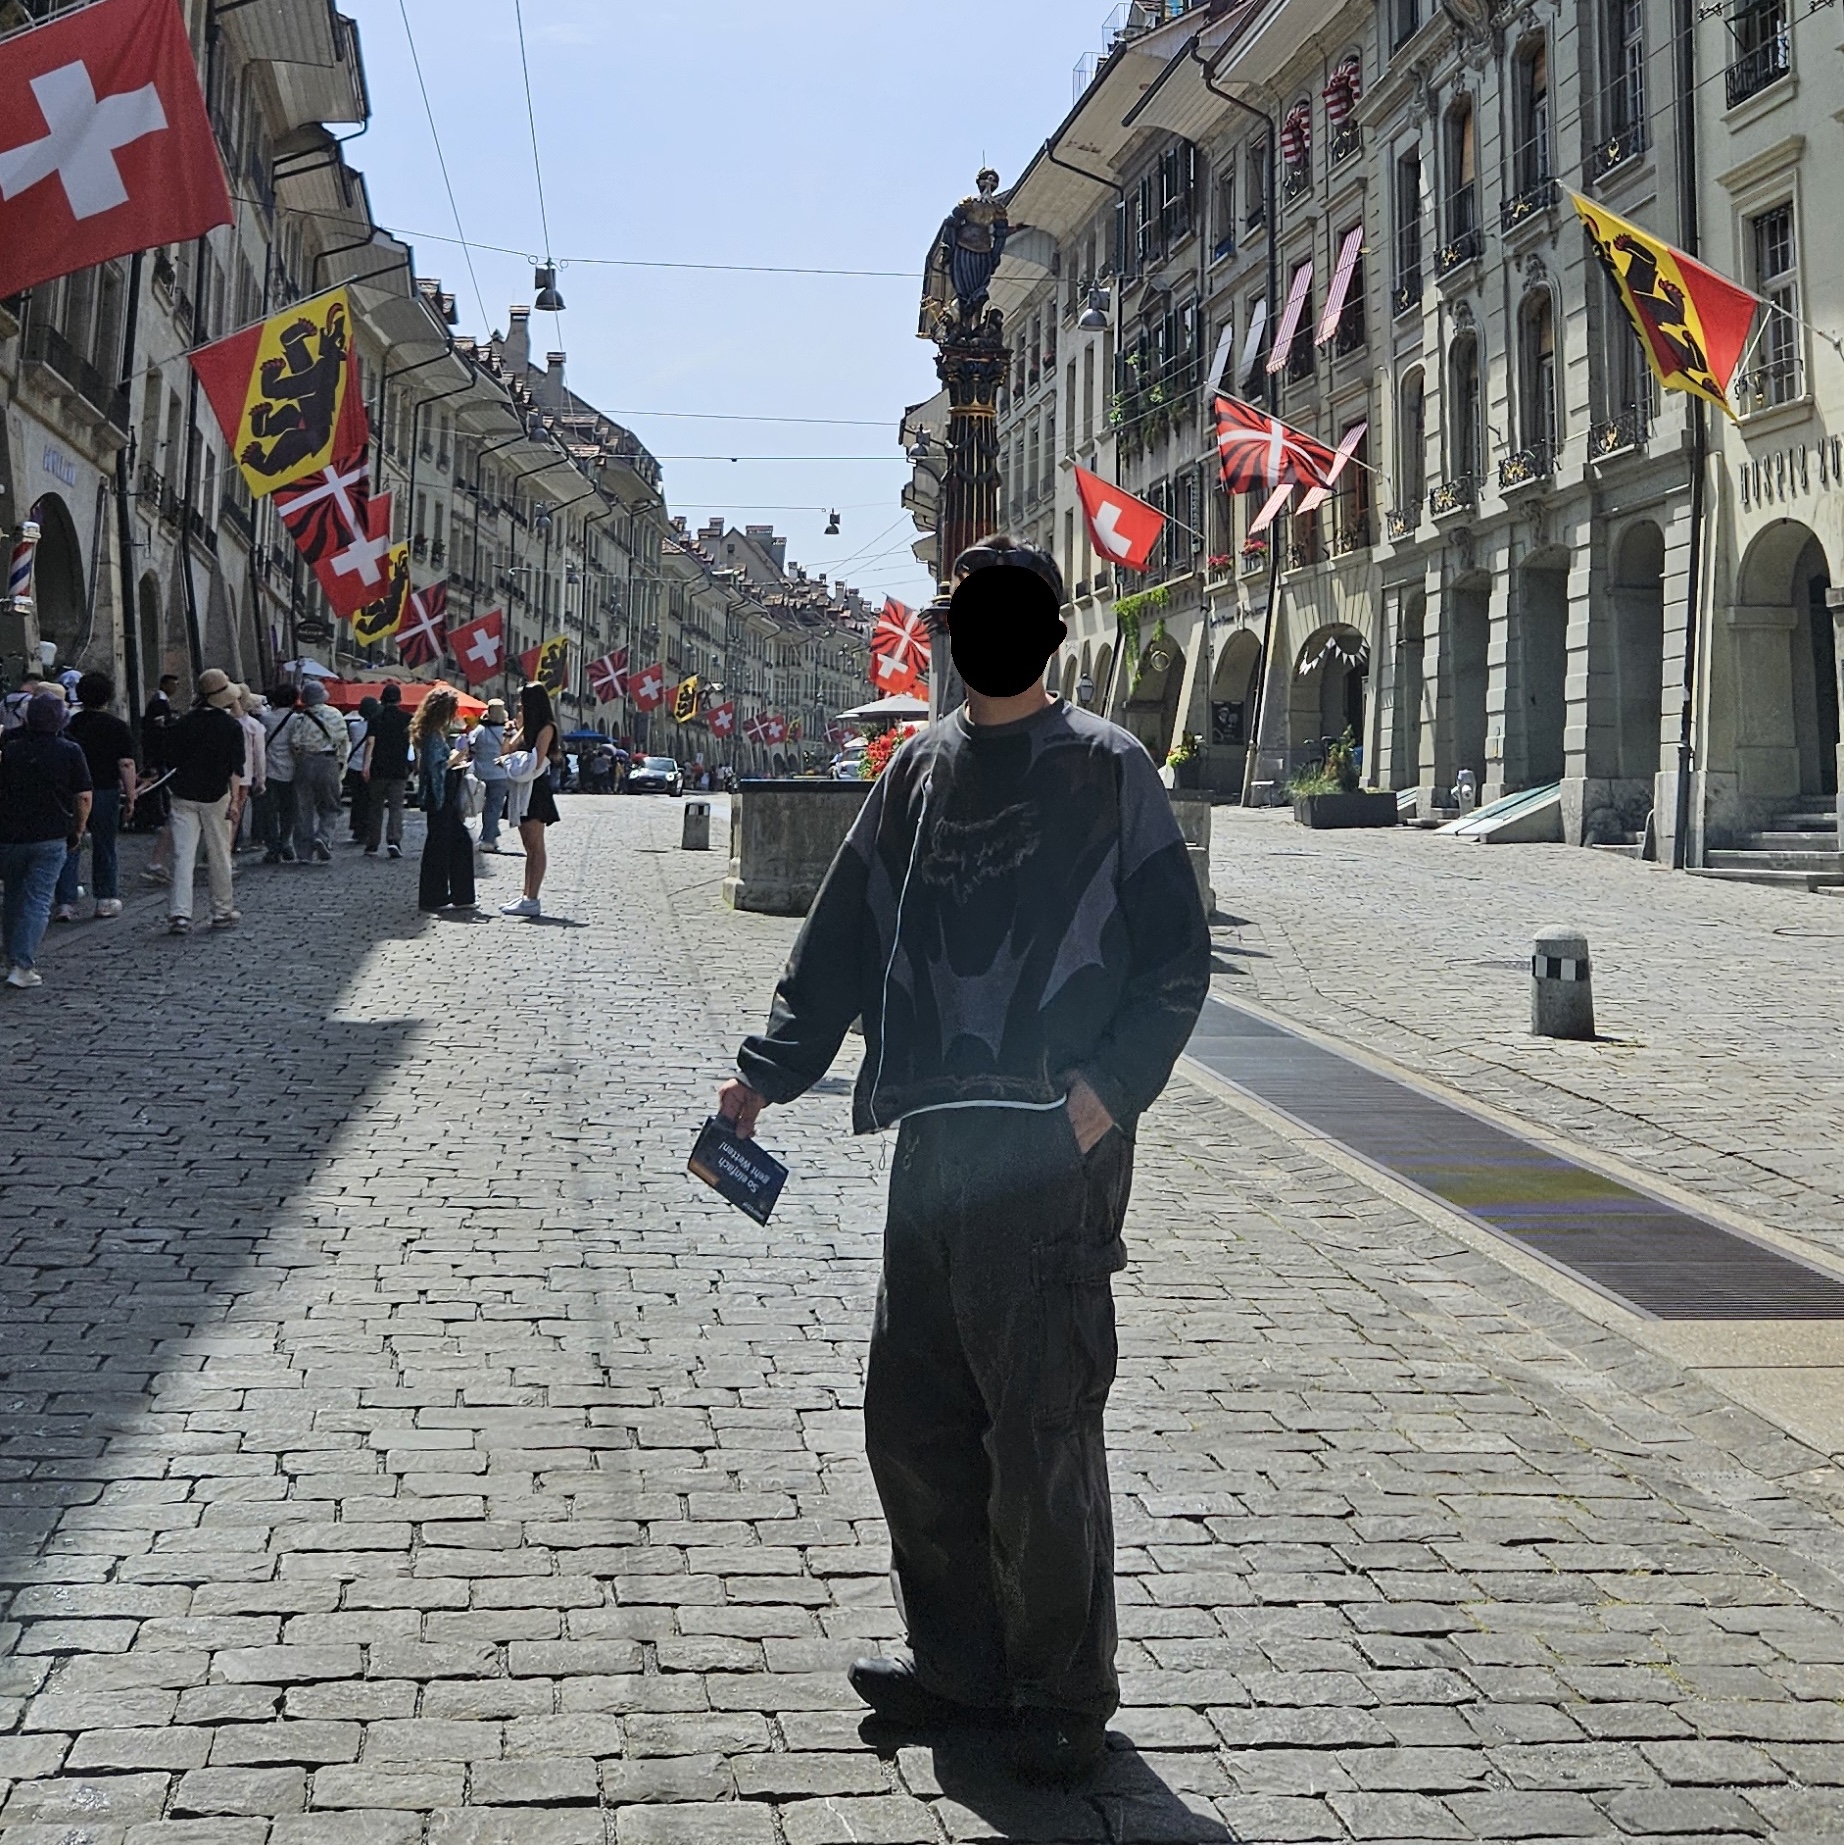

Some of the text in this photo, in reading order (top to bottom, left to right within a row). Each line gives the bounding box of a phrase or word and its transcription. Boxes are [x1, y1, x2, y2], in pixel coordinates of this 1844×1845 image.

[1738, 444, 1806, 503] HOSPIZ
[718, 1142, 751, 1172] Wetten!
[718, 1157, 759, 1193] So einfach
[750, 1167, 770, 1184] geht
